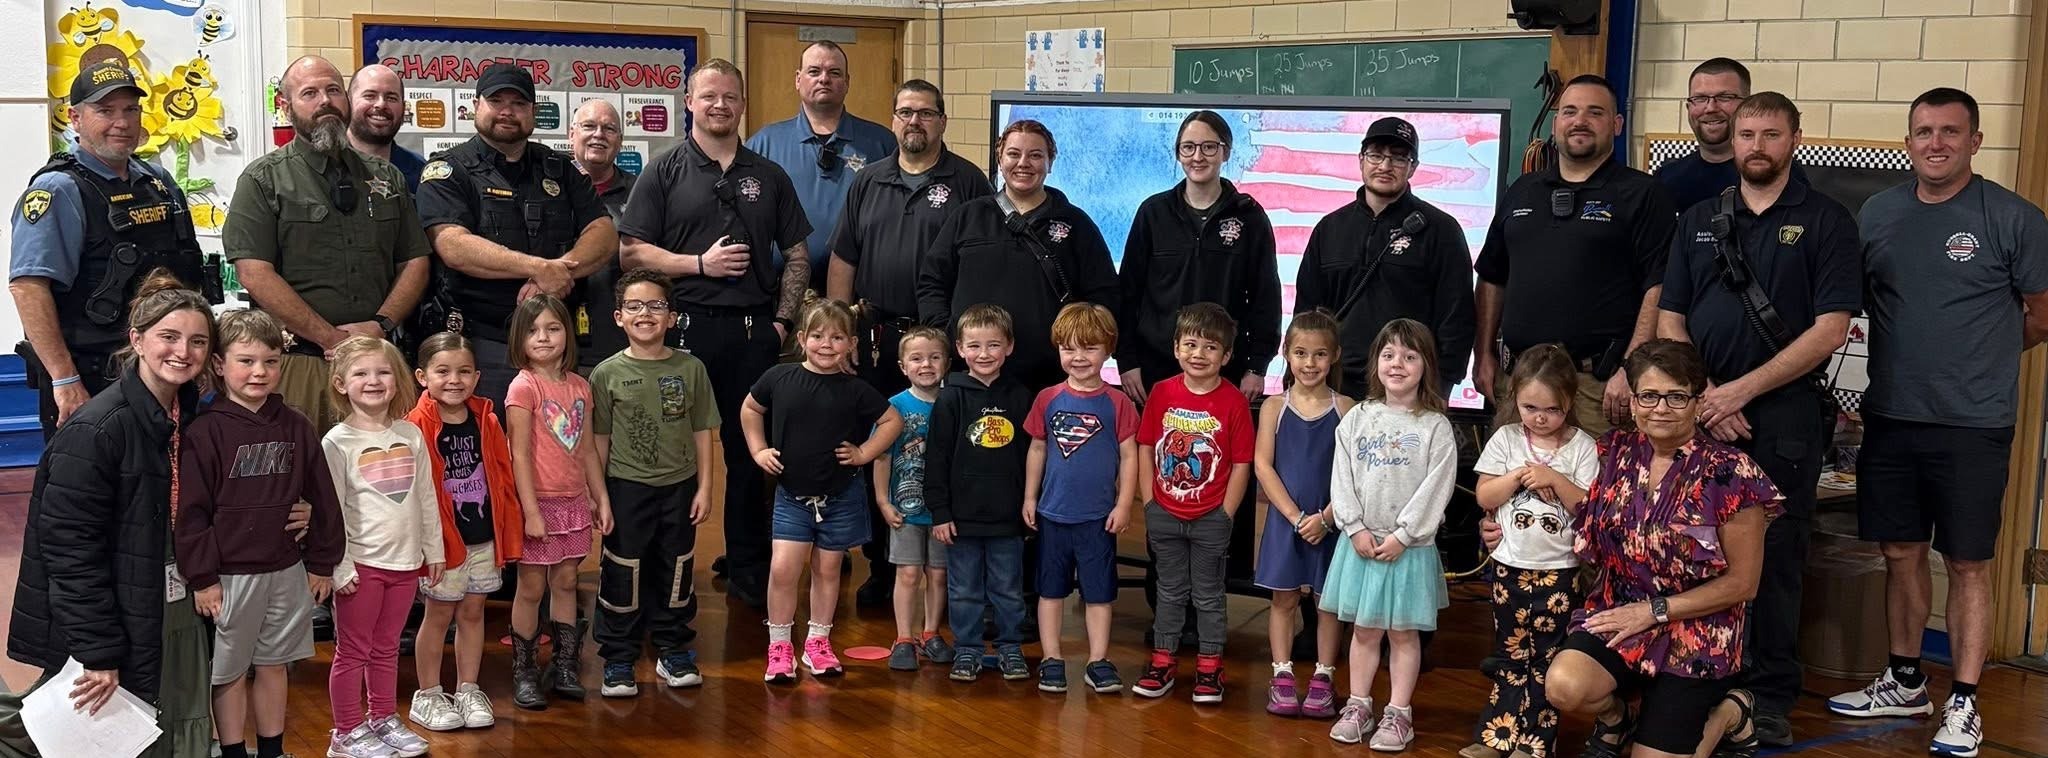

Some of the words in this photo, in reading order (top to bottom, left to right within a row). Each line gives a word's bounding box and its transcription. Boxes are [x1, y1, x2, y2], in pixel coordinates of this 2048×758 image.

[1273, 52, 1292, 75] 25
[1294, 52, 1334, 72] Jumps
[1366, 48, 1390, 76] 35
[1395, 47, 1440, 70] Jumps
[92, 71, 130, 85] SHERIFF
[571, 60, 682, 90] STRONG
[1188, 60, 1204, 85] 10
[1209, 58, 1254, 83] Jumps
[408, 92, 433, 100] RESPECT
[628, 97, 666, 105] PERSEVERANCE
[1158, 111, 1173, 120] 014
[129, 205, 167, 225] SHERIFF
[621, 378, 643, 387] TMNT
[987, 416, 1005, 426] Bass
[1175, 410, 1210, 419] AMAZING
[987, 426, 1002, 435] Pro
[450, 434, 474, 451] JUST
[987, 434, 1010, 445] Shops
[1356, 433, 1387, 460] Girl
[228, 441, 296, 479] NIKE
[452, 450, 477, 468] GIRL
[1367, 452, 1411, 472] Power
[452, 466, 472, 479] LOVES
